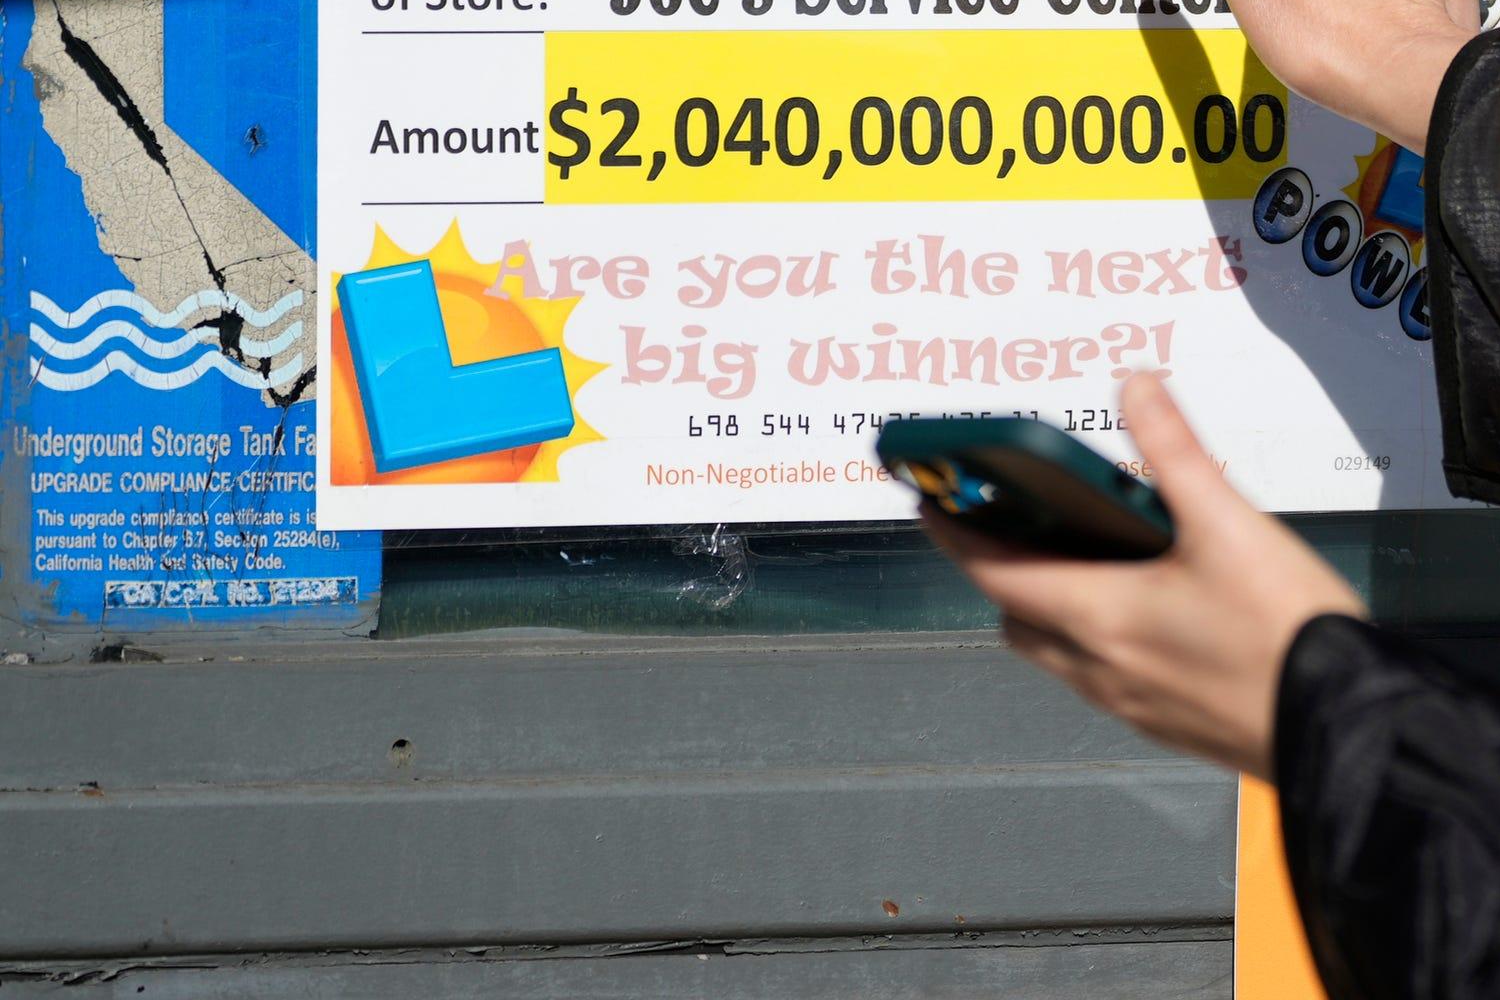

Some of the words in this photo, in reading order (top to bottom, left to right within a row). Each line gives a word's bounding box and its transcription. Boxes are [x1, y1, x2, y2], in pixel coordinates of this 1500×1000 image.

[370, 120, 540, 155] Amount
[548, 87, 1286, 181] $2,040,000,000.00
[485, 239, 650, 302] Are
[678, 251, 839, 308] you
[865, 234, 1018, 298] the
[1045, 235, 1248, 298] next
[619, 323, 758, 400] big
[788, 320, 1175, 386] winner?!
[688, 414, 739, 437] 698
[761, 413, 811, 436] 544
[14, 425, 143, 464] Underground
[151, 425, 232, 464] Storage
[240, 425, 286, 456] Tank
[647, 460, 835, 488] Non-Negotiable
[1334, 456, 1391, 471] 029149
[31, 472, 113, 493] UPGRADE
[120, 472, 231, 493] COMPLIANCE
[239, 471, 316, 493] CERTIFIC
[37, 509, 64, 526] This
[70, 509, 125, 529] upgrade
[131, 508, 208, 529] compliance
[289, 508, 300, 525] is
[36, 532, 96, 552] pursuant
[103, 533, 117, 548] to
[122, 531, 178, 551] Chapter
[36, 554, 102, 571] California
[109, 554, 153, 571] Health
[245, 553, 286, 570] Code.
